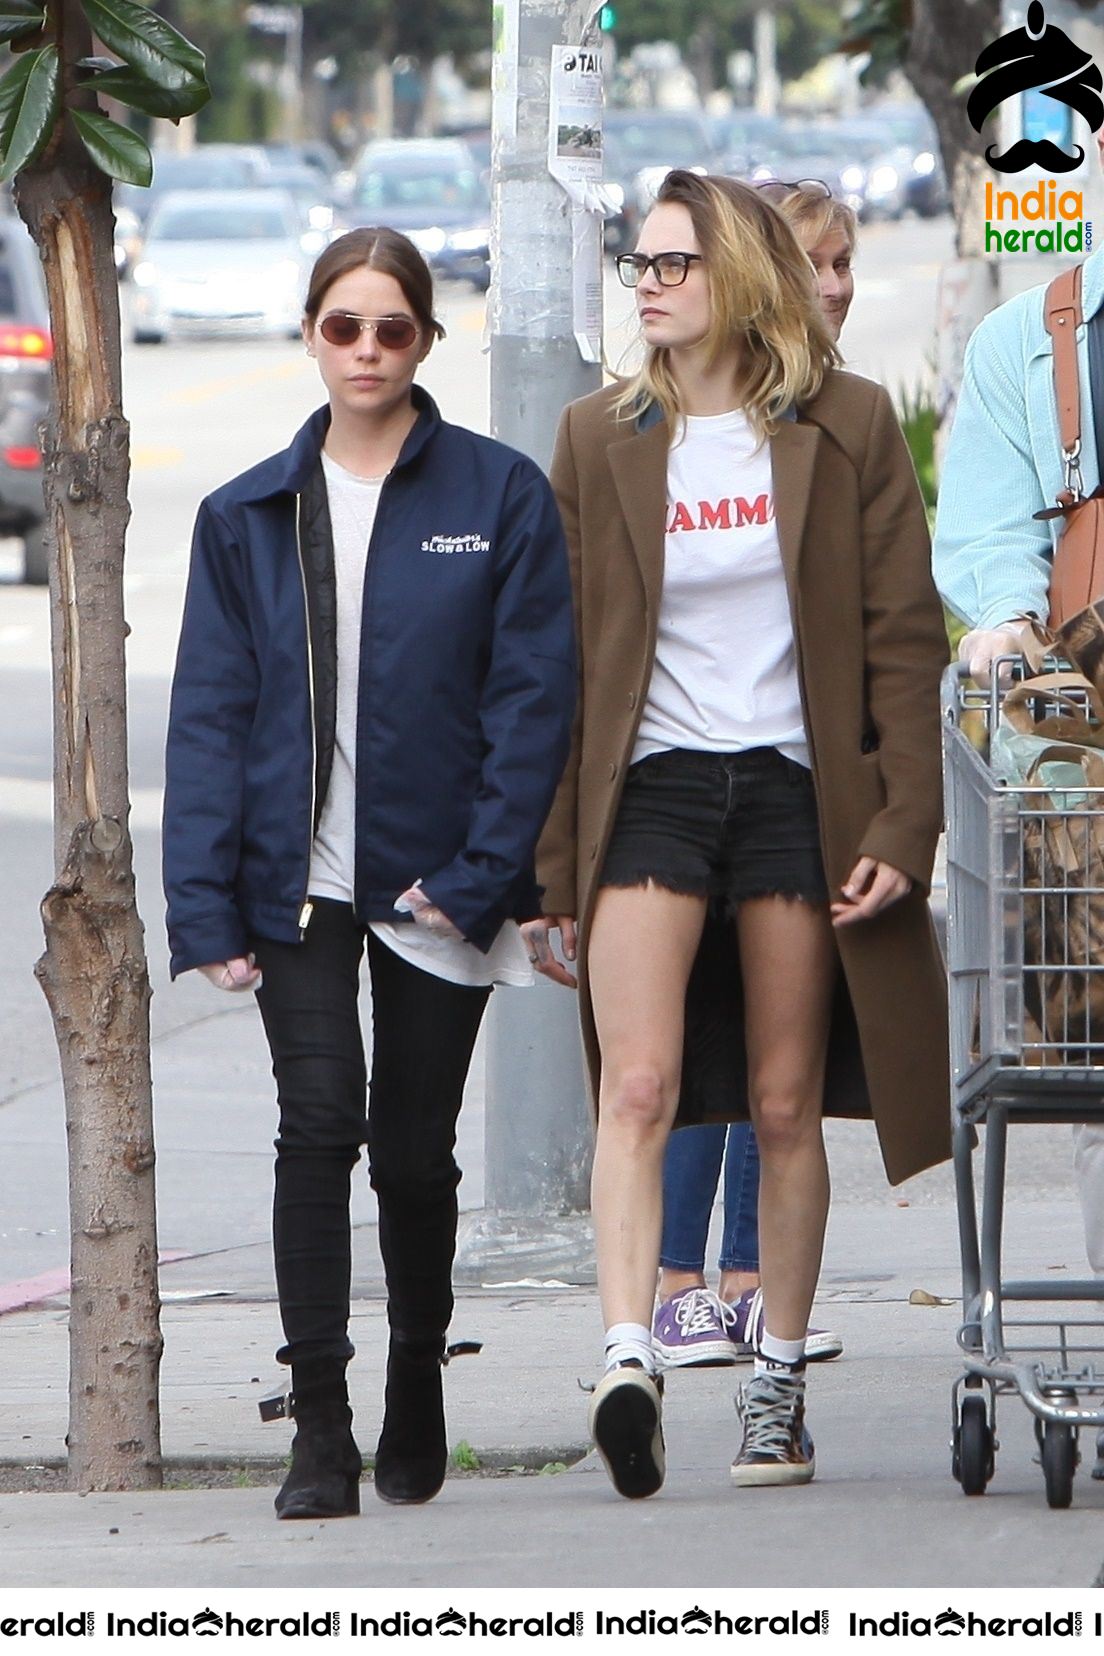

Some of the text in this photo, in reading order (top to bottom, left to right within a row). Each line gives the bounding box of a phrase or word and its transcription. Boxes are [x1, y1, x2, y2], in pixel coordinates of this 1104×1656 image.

[665, 494, 774, 533] AMM
[421, 541, 454, 553] SLOW
[465, 541, 490, 552] LOW
